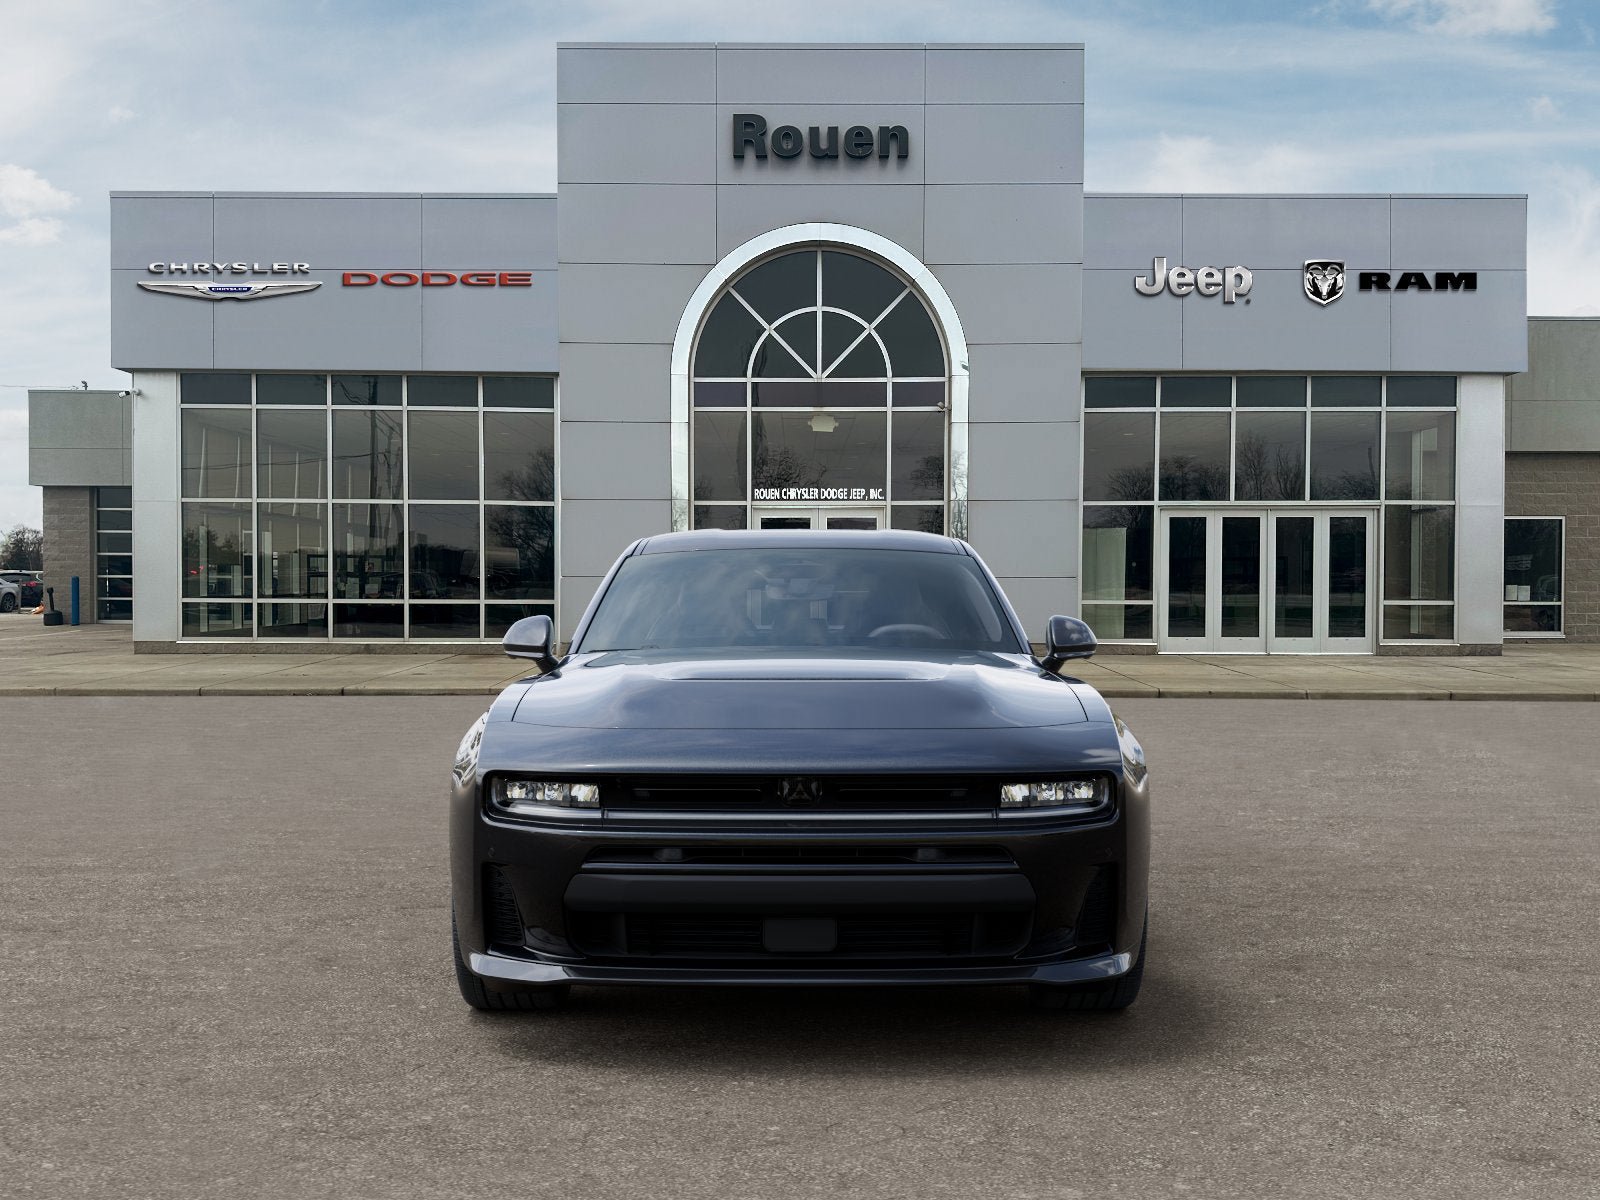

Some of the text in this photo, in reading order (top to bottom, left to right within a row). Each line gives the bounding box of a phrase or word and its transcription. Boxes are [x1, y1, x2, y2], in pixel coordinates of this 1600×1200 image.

[733, 113, 909, 158] Rouen
[148, 262, 311, 274] CHRYSLER
[341, 272, 533, 287] DODGE
[1135, 256, 1253, 304] Jeep
[1358, 272, 1478, 291] RAM
[754, 488, 885, 501] ROUEN CHRYSLER DODGE JEEP, INC.
